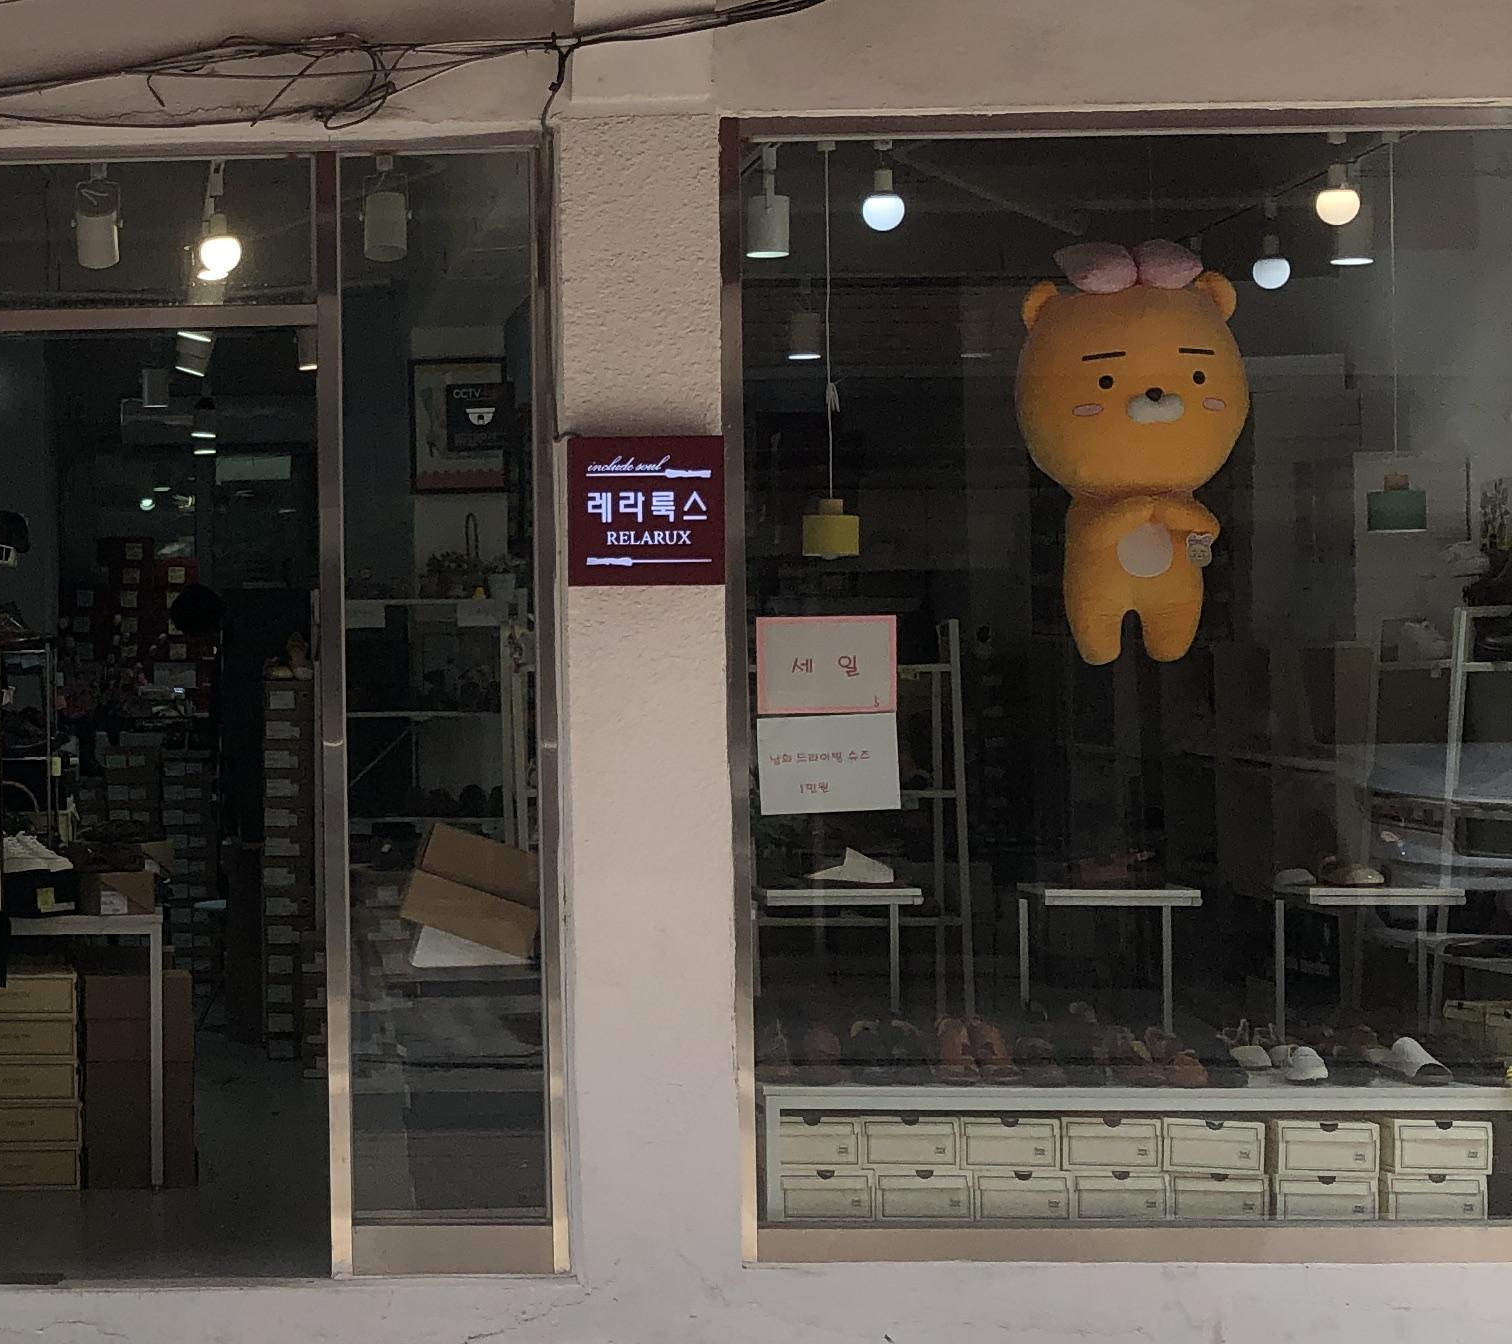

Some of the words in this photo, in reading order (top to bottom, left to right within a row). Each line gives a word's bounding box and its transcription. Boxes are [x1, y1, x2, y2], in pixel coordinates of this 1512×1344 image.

[452, 388, 481, 399] CCTV
[587, 455, 635, 472] include
[635, 454, 671, 472] soul
[587, 490, 708, 524] 레라룩스
[606, 530, 692, 546] RELARUX
[848, 749, 871, 761] 슈즈
